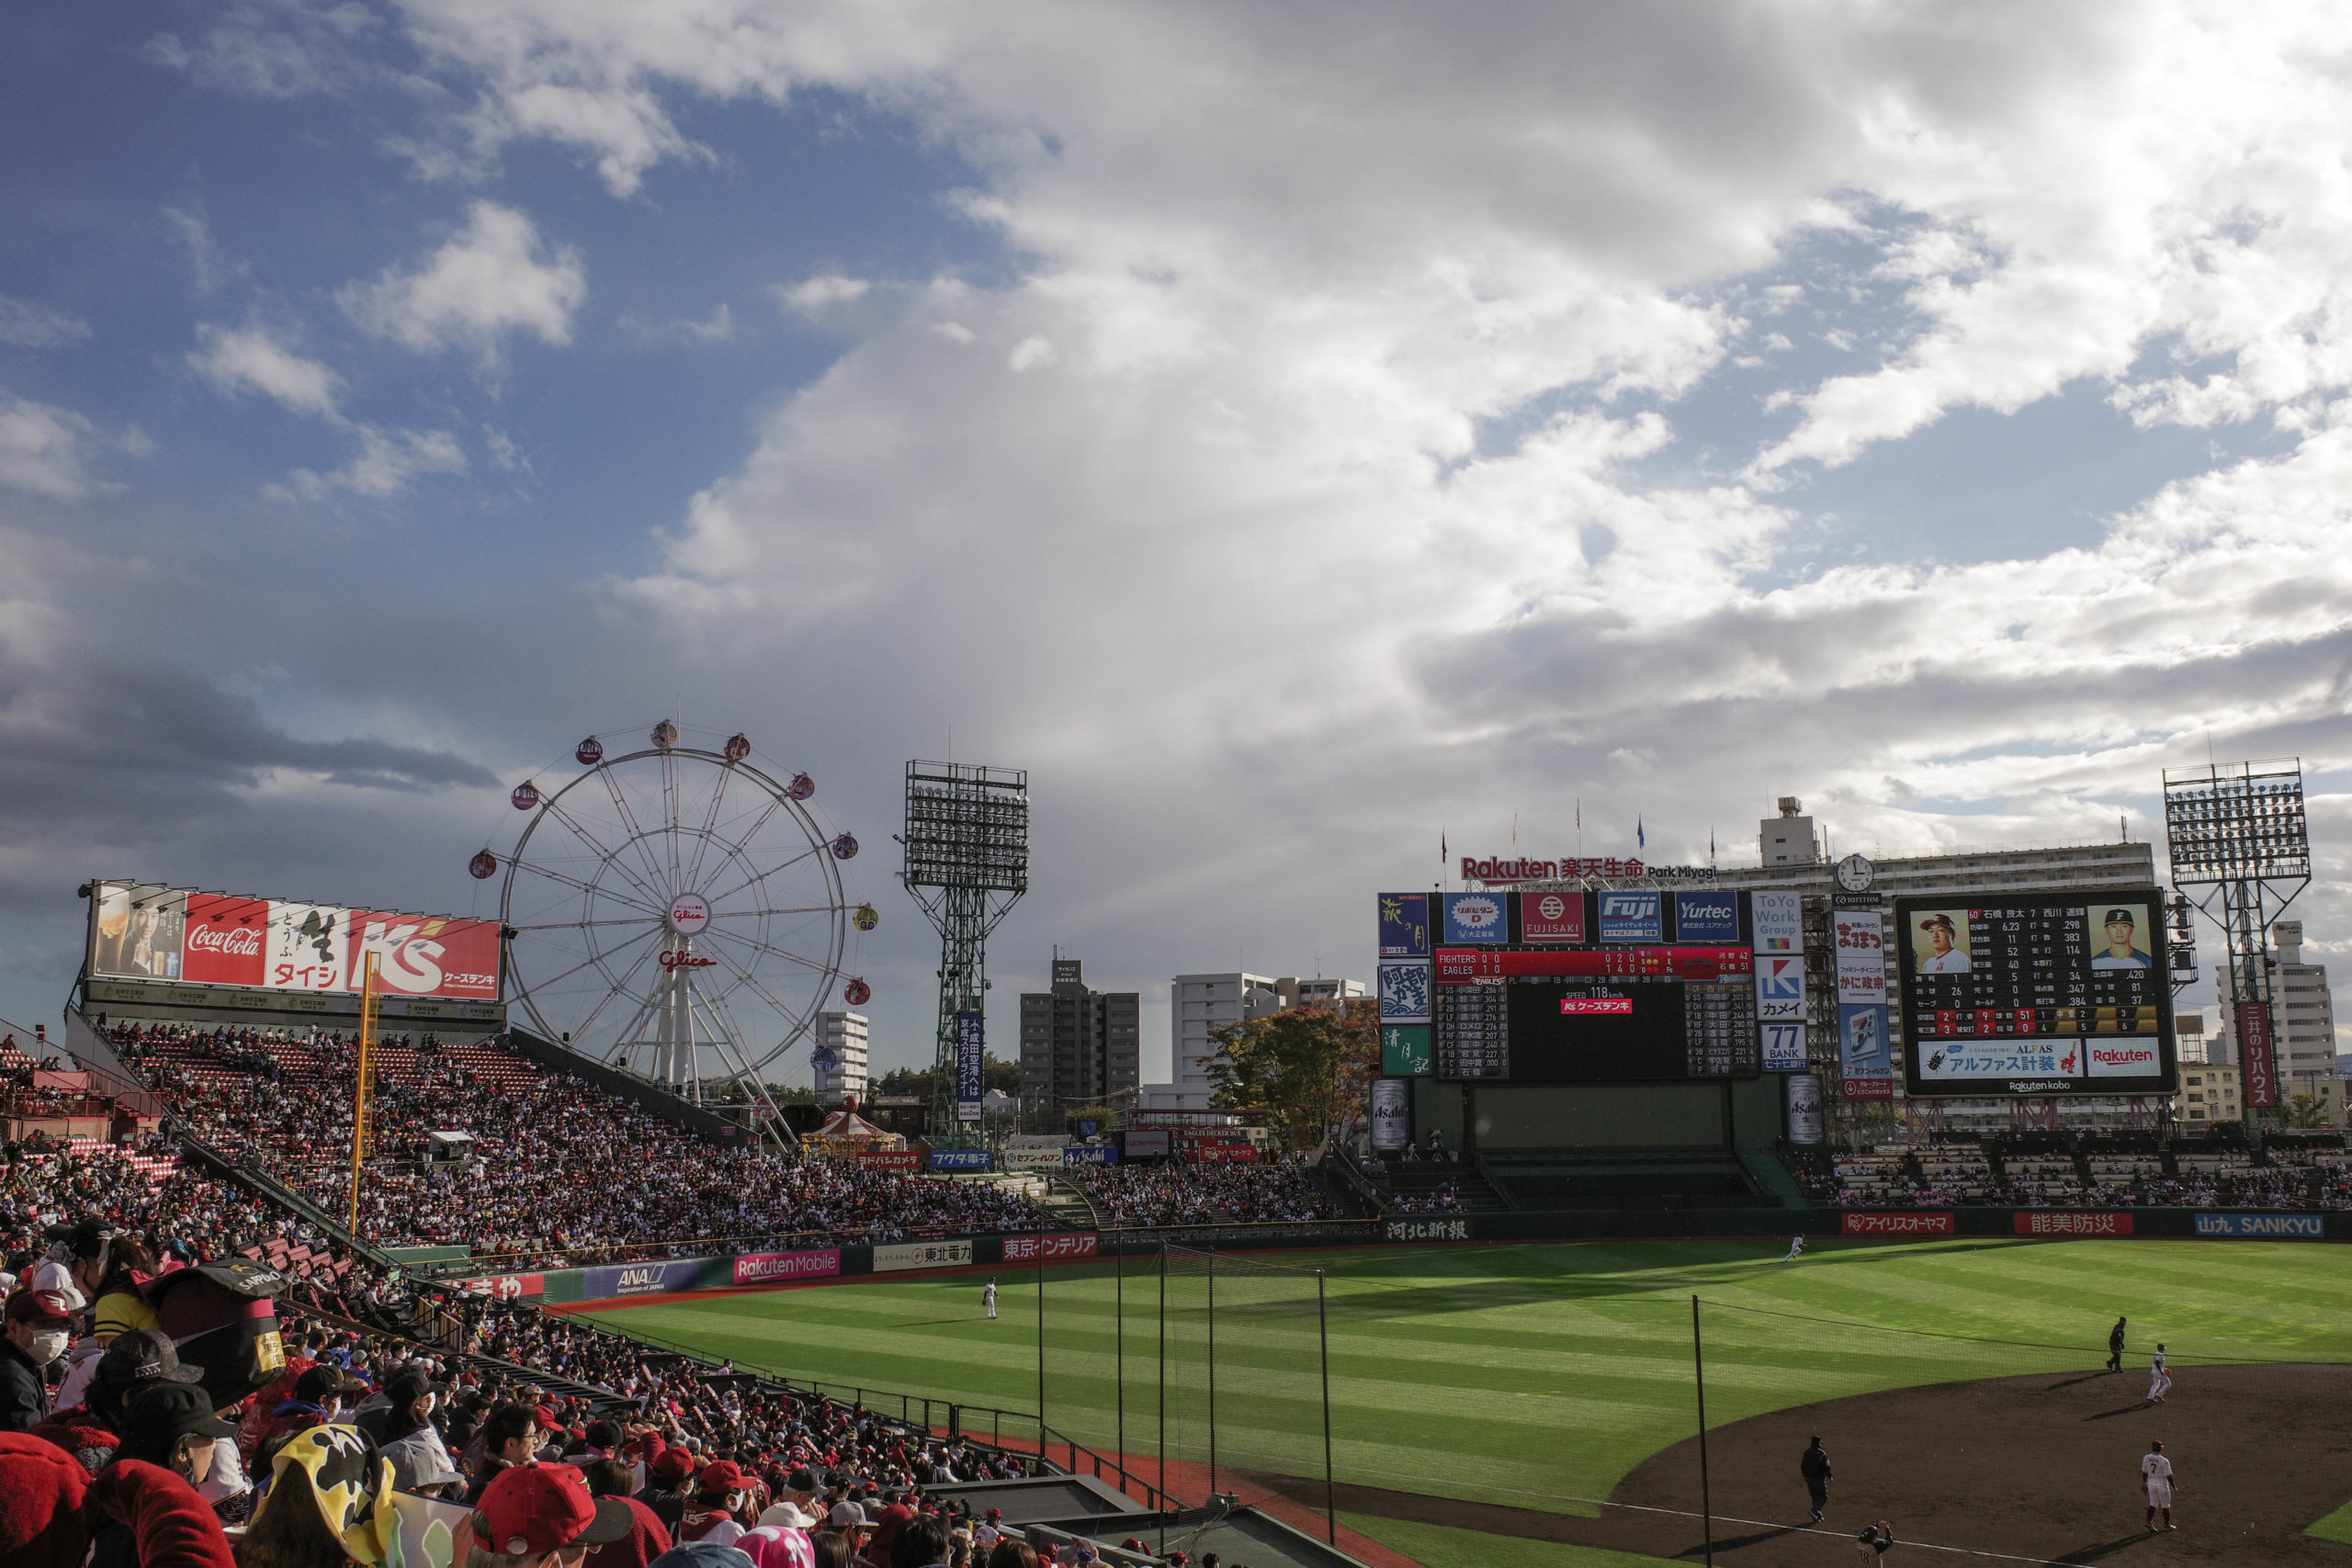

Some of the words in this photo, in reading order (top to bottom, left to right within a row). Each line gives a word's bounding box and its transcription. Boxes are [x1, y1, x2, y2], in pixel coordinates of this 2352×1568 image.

[1463, 856, 1557, 880] Rakuten
[1562, 857, 1645, 878] 楽天生命
[1647, 866, 1676, 877] Park
[1679, 865, 1716, 879] Miyagi
[1603, 896, 1657, 919] Fuji
[1758, 896, 1794, 908] ToYo
[673, 910, 706, 922] Glico
[1680, 902, 1732, 919] Yurtec
[1756, 909, 1800, 922] Work.
[1969, 910, 1978, 919] 60
[2030, 909, 2036, 918] 7
[2043, 908, 2062, 918] 西川
[1471, 915, 1481, 923] D
[2003, 922, 2019, 931] 6.23
[2063, 920, 2080, 930] .298
[279, 912, 293, 957] とうふ
[1526, 923, 1578, 933] FUJISAKI
[1759, 925, 1796, 936] Group
[188, 923, 265, 956] Coca-Cola
[1837, 922, 1882, 949] まるまつ
[2007, 935, 2016, 943] 11
[2064, 933, 2080, 942] 383
[350, 920, 447, 993] K's
[1739, 952, 1748, 960] 42
[2007, 948, 2018, 956] 52
[2065, 946, 2080, 954] 114
[659, 950, 717, 974] Glico
[1439, 954, 1476, 964] FIGHTERS
[1482, 954, 1487, 964] 0
[1494, 954, 1499, 964] 0
[1605, 953, 1611, 963] 0
[1617, 953, 1622, 963] 2
[1629, 953, 1634, 963] 0
[2008, 960, 2019, 969] 40
[2071, 958, 2076, 967] 4
[1443, 965, 1473, 975] EAGLES
[1483, 964, 1487, 974] 1
[1495, 964, 1499, 974] 0
[1607, 964, 1611, 974] 1
[1617, 964, 1623, 974] 4
[1630, 964, 1634, 974] 0
[1741, 963, 1747, 971] 51
[275, 964, 337, 988] タイシ
[444, 972, 495, 985] ケーズデンキ
[1476, 977, 1502, 986] EAGLES
[1839, 976, 1883, 989] かに政宗
[1954, 974, 1958, 983] 1
[2070, 972, 2080, 980] 34
[2126, 970, 2144, 979] .420
[1590, 987, 1608, 998] 118
[1951, 987, 1962, 996] 26
[2013, 985, 2018, 994] 0
[2067, 984, 2085, 993] .347
[2132, 983, 2141, 991] 81
[1565, 1002, 1576, 1010] K's
[1578, 1002, 1629, 1010] ケーズデンキ
[1954, 999, 1960, 1008] 0
[2013, 998, 2018, 1008] 0
[2068, 997, 2086, 1006] .384
[2132, 996, 2142, 1005] 37
[1763, 1002, 1801, 1016] カメイ
[1943, 1013, 1949, 1021] 2
[1983, 1011, 1987, 1021] 9
[2020, 1010, 2030, 1020] 51
[1944, 1025, 1950, 1034] 3
[1984, 1024, 1989, 1033] 2
[2022, 1024, 2028, 1032] 0
[1769, 1026, 1799, 1049] 77
[1384, 1029, 1430, 1073] 清月記
[1770, 1049, 1799, 1059] BANK
[2016, 1045, 2053, 1054] ALFAS
[2093, 1049, 2153, 1063] Rakuten
[2247, 1006, 2267, 1103] 三井のリハウス
[960, 1019, 969, 1097] 京成スカイライナー
[969, 1033, 979, 1096] 成田空港へは
[1950, 1056, 2055, 1072] アルファス計装
[2009, 1081, 2047, 1091] Rakuten
[2048, 1081, 2070, 1089] kobo
[1374, 1105, 1405, 1119] Asahi
[858, 1156, 919, 1166] ヨドバシカメラ
[1076, 1148, 1104, 1163] Asahi
[1866, 1216, 1947, 1231] アイリスオーヤマ
[2030, 1213, 2116, 1233] 能美防災
[2198, 1217, 2233, 1233] 山九
[2241, 1217, 2322, 1235] SANKYU
[1386, 1220, 1469, 1240] 河北新報
[1004, 1236, 1096, 1259] 東京インテリア
[924, 1247, 972, 1263] 東北電力
[738, 1257, 794, 1277] Rakuten
[796, 1254, 836, 1272] Mobile
[617, 1269, 648, 1287] ANA
[2151, 1462, 2156, 1473] 7
